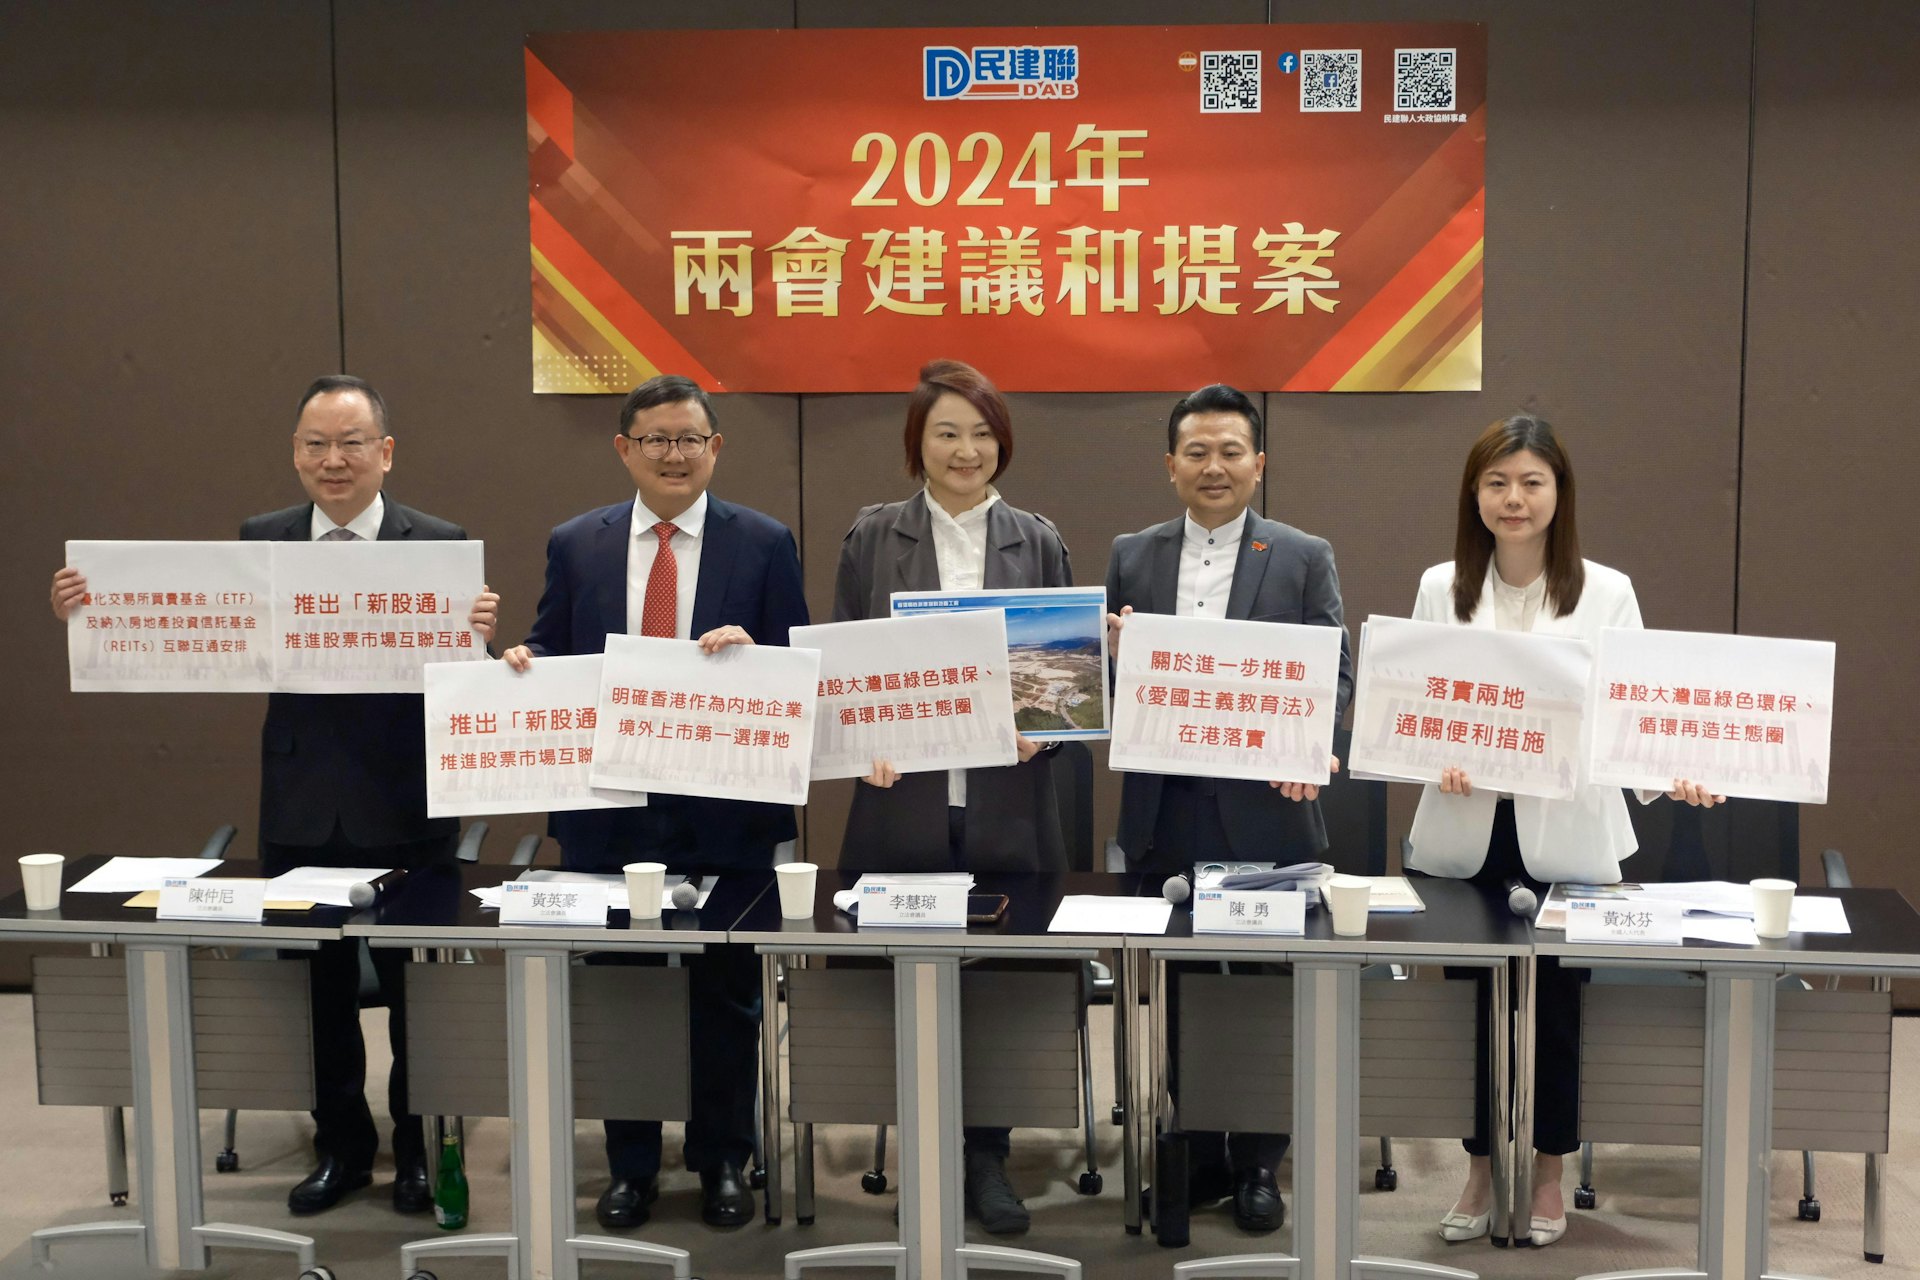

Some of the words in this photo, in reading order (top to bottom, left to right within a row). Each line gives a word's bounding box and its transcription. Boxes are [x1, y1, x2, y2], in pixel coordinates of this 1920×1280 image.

[975, 48, 1076, 80] 民建聯
[1023, 84, 1075, 96] DAB
[1383, 113, 1467, 123] 民建聯人大政協辦事處
[850, 124, 1150, 212] 2024年
[670, 222, 1342, 317] 兩會建議和提案
[294, 592, 453, 616] 推出「新股通」
[86, 616, 256, 629] 及納入房地產投資信託基金
[285, 630, 473, 650] 推進股票市場互聯互通
[1151, 650, 1306, 682] 關於進一步推動
[611, 687, 803, 719] 明確香港作為內地企業
[1134, 683, 1316, 718] 《愛國主義教育法》
[1425, 676, 1525, 710] 落實兩地
[1609, 682, 1813, 713] 建設大灣區綠色環保、
[450, 706, 598, 736] 推出「新股通
[840, 697, 972, 726] 循環再造生態圈
[618, 718, 790, 749] 境外上市第一選擇地
[1178, 724, 1267, 750] 在港落實
[1395, 712, 1545, 755] 通關便利措施
[1639, 716, 1785, 744] 循環再造生態圈
[440, 747, 593, 771] 推進股票市場互聯
[188, 888, 234, 904] 陳仲尼
[531, 892, 579, 909] 黃英豪
[1602, 910, 1654, 928] 黃冰芬
